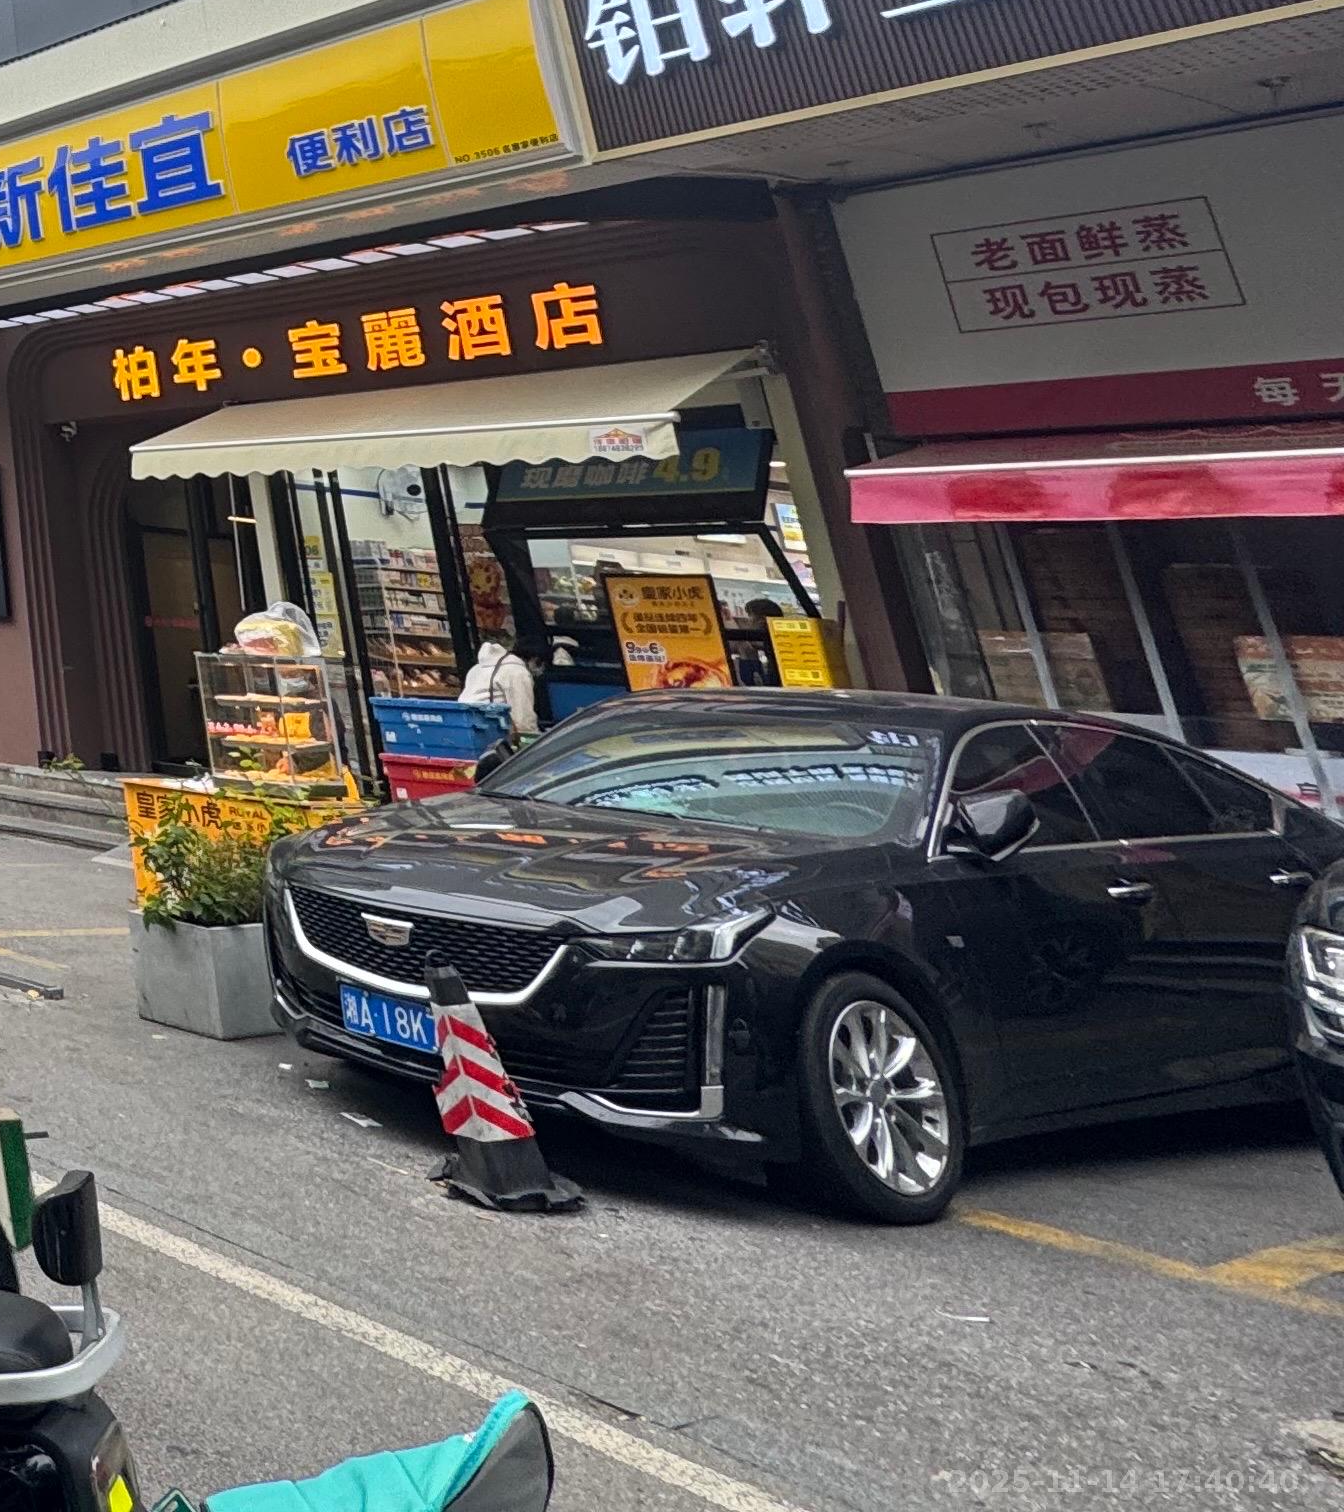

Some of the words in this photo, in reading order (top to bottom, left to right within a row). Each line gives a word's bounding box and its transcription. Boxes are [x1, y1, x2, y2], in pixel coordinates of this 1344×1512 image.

[286, 106, 435, 178] 便利店
[971, 212, 1193, 272] 老面鲜蒸
[983, 264, 1211, 322] 现包现蒸
[520, 461, 649, 489] 现磨咖啡
